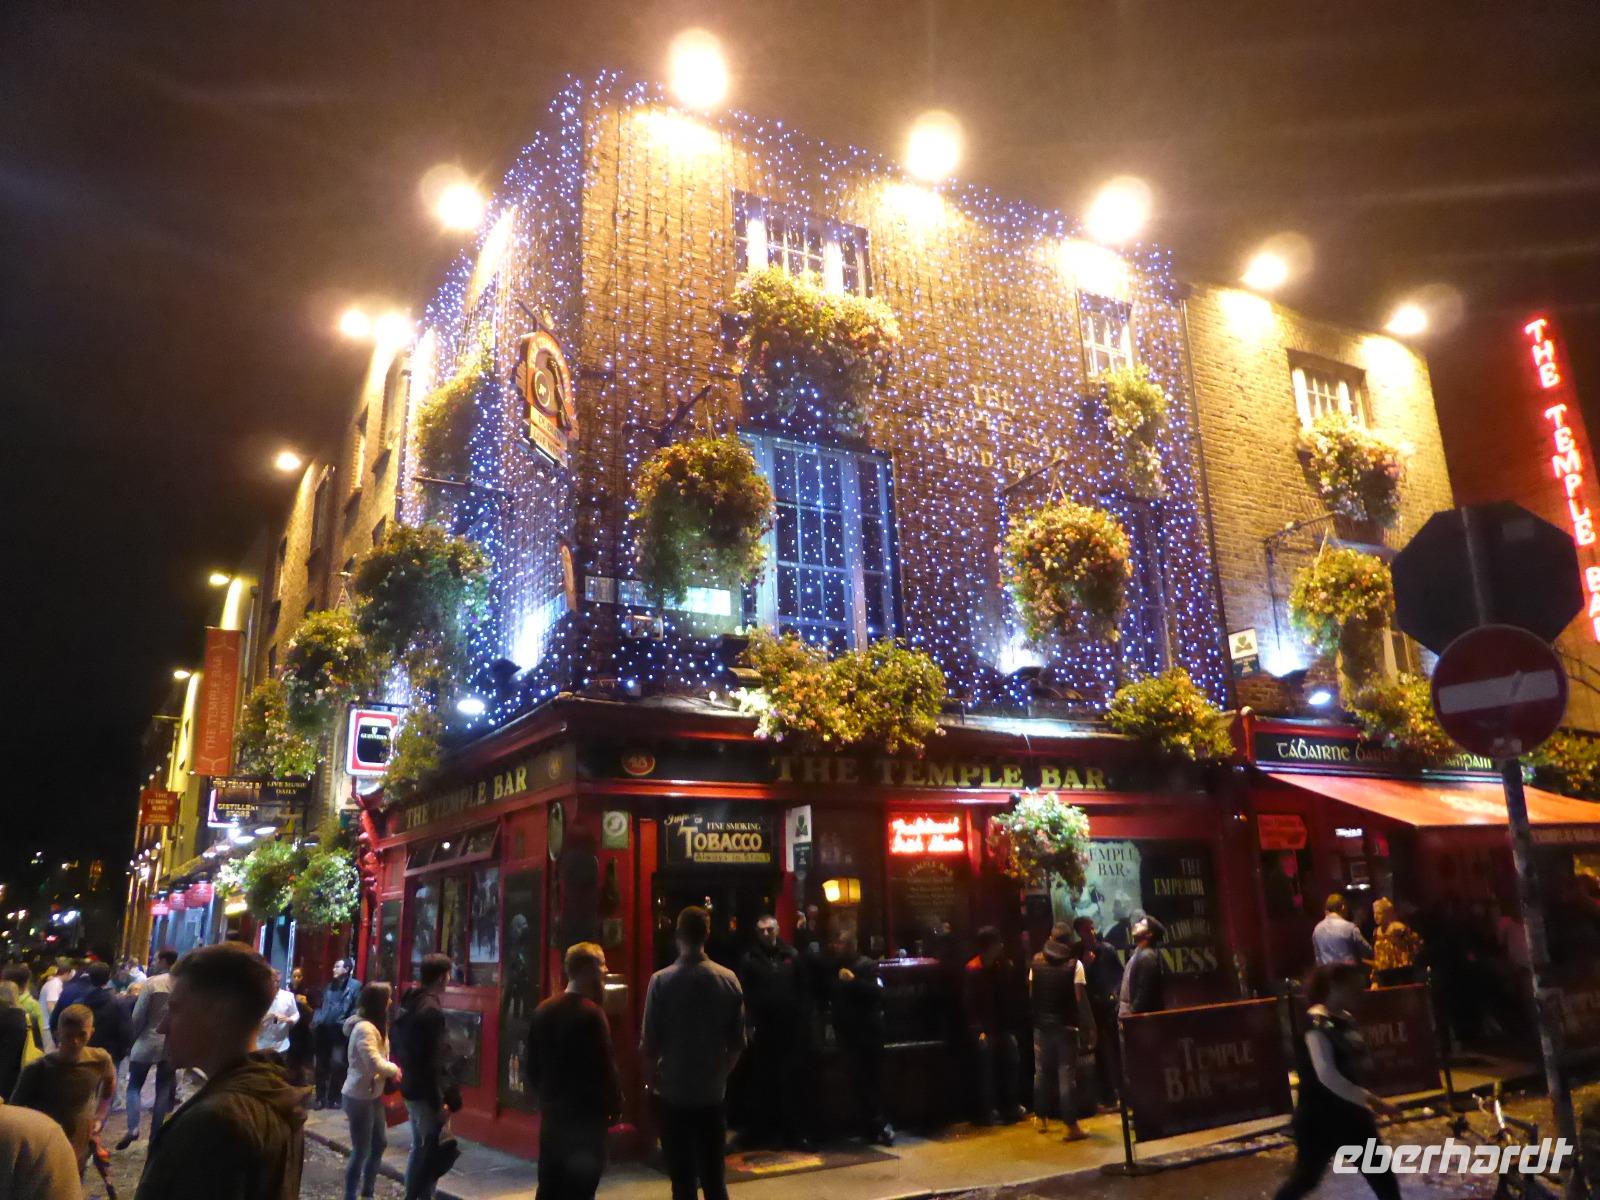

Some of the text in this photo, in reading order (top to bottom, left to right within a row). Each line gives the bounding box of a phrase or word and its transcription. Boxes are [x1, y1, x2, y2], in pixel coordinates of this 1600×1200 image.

[1523, 317, 1562, 389] THE
[1543, 402, 1597, 547] TEMPLE
[771, 757, 1106, 790] THE TEMPLE BAR
[406, 803, 429, 830] THE
[494, 766, 527, 800] BAR
[677, 826, 762, 859] TOBACCO
[707, 822, 761, 831] FINE SMOKING
[1098, 862, 1126, 877] BAR
[1179, 1037, 1255, 1072] TEMPLE
[1164, 1067, 1213, 1103] BAR
